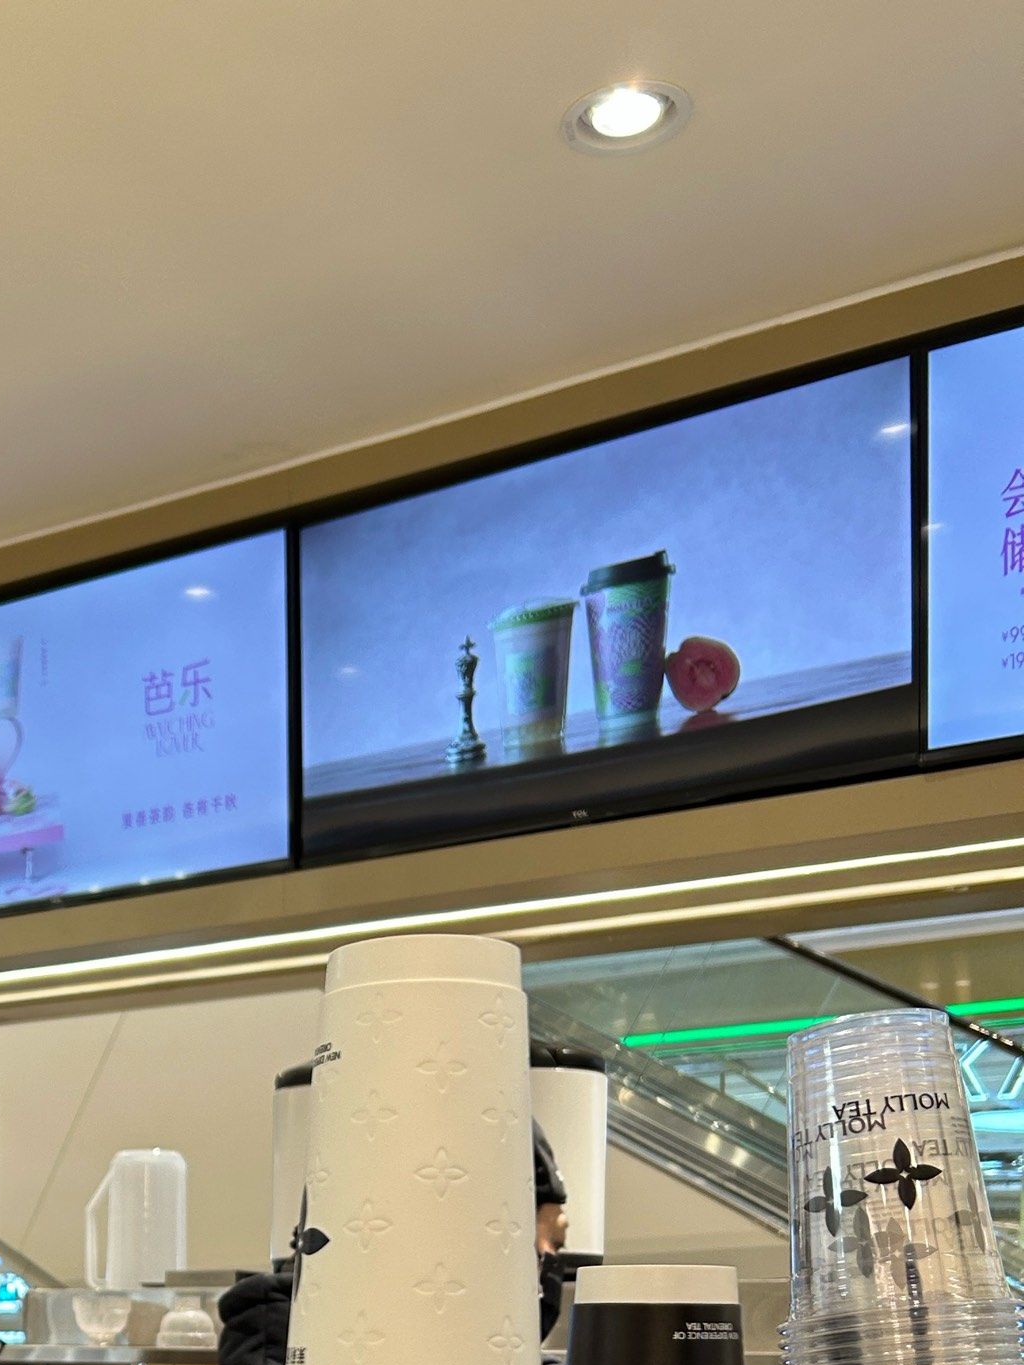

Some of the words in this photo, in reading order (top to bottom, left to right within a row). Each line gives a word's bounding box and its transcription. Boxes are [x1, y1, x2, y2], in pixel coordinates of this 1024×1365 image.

[141, 656, 213, 716] 芭乐
[832, 1099, 877, 1121] TEA
[882, 1092, 950, 1116] MOLLY
[794, 1129, 813, 1149] TE
[816, 1112, 887, 1142] MOLLY
